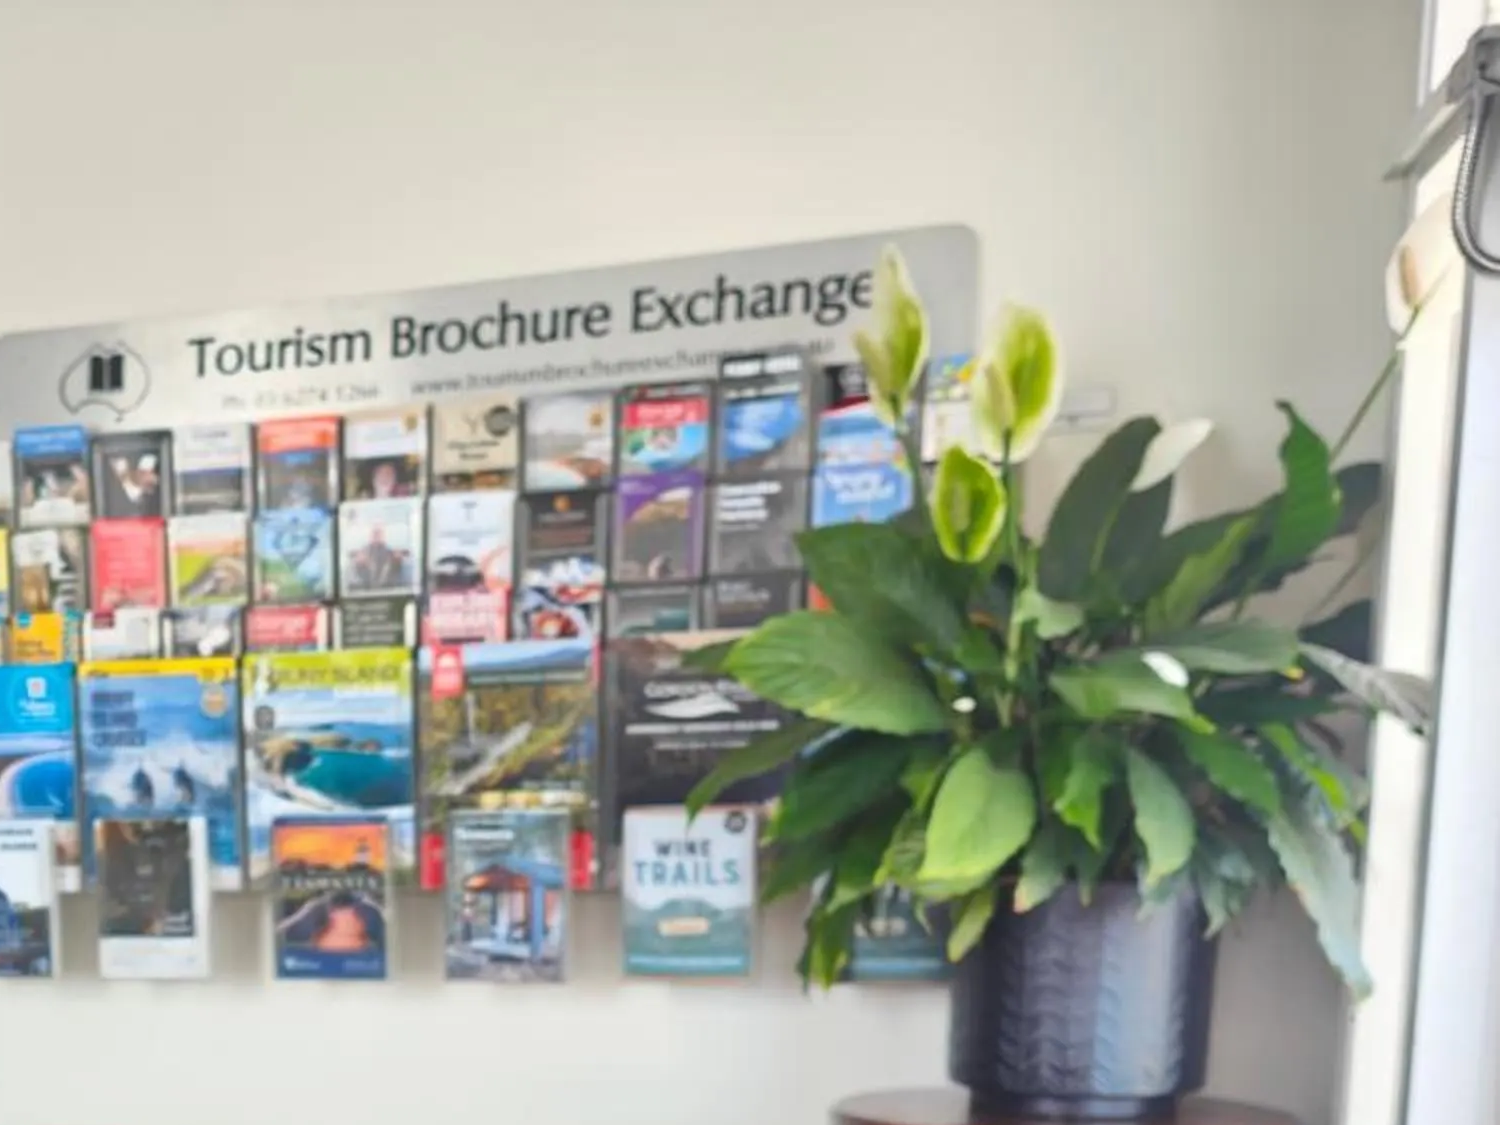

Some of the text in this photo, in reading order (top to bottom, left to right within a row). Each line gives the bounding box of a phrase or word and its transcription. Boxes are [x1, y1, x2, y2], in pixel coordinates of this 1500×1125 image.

[188, 270, 875, 378] Tourism Brochure Exchange
[654, 839, 711, 857] WINE
[634, 861, 740, 886] TRAILS
